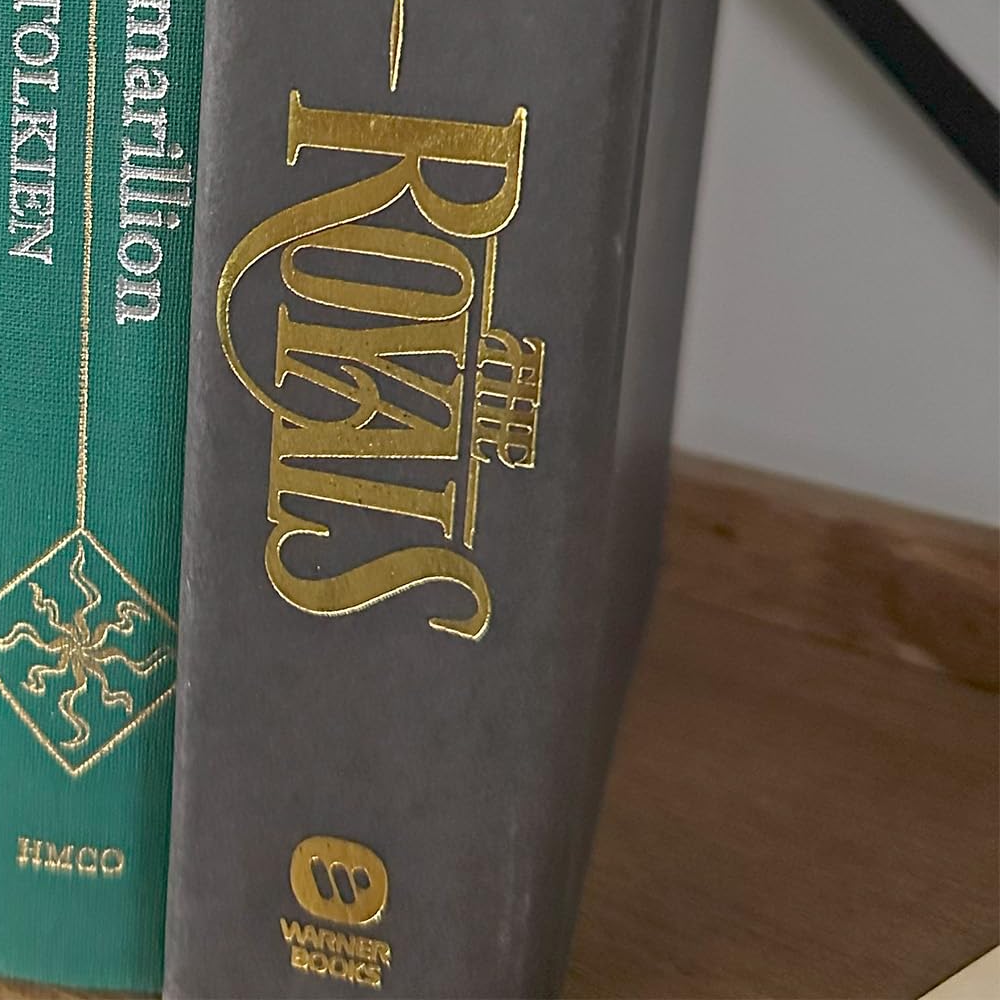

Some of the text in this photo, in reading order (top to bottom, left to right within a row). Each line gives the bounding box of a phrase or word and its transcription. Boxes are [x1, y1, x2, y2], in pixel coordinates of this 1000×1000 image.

[216, 90, 528, 641] ROYALS
[16, 836, 125, 874] HMCO
[279, 917, 391, 967] WARNER
[291, 946, 382, 987] BOOKS
